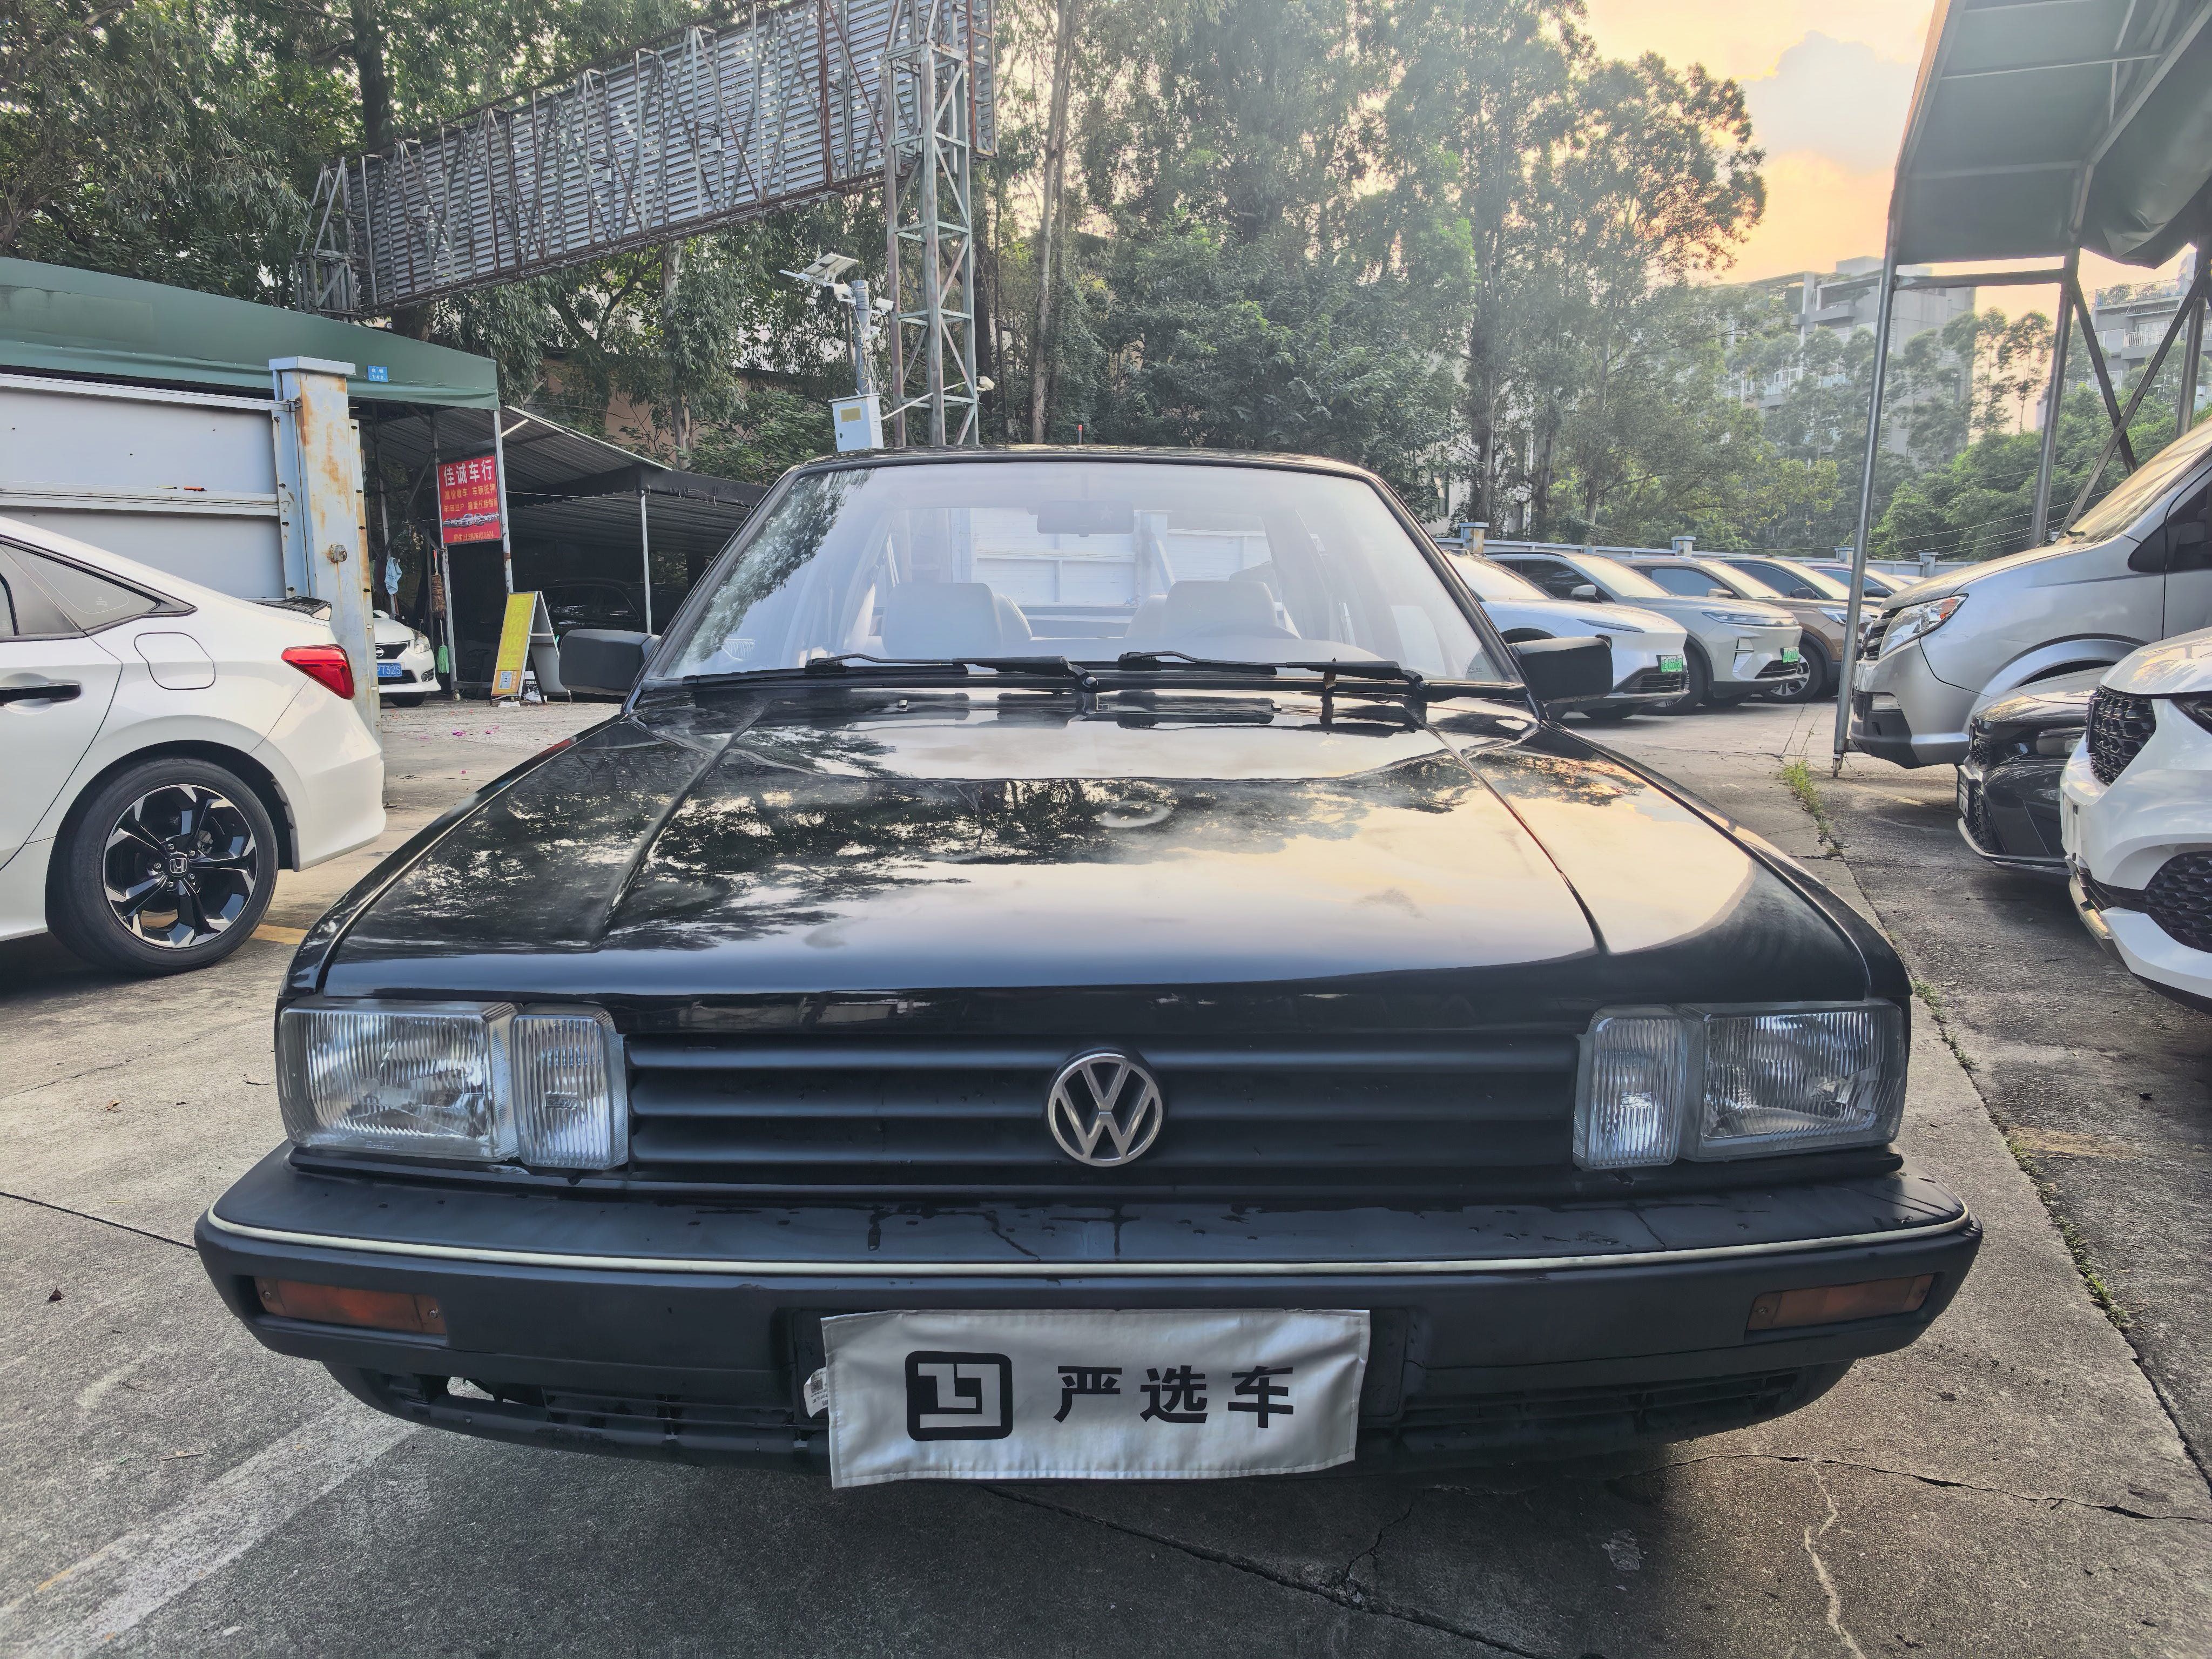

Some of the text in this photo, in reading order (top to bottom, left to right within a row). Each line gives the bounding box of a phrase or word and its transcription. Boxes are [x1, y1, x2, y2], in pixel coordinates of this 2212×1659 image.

[444, 460, 492, 487] 佳诚车行
[1048, 1053, 1163, 1166] VW
[1053, 1365, 1293, 1428] 严选车
